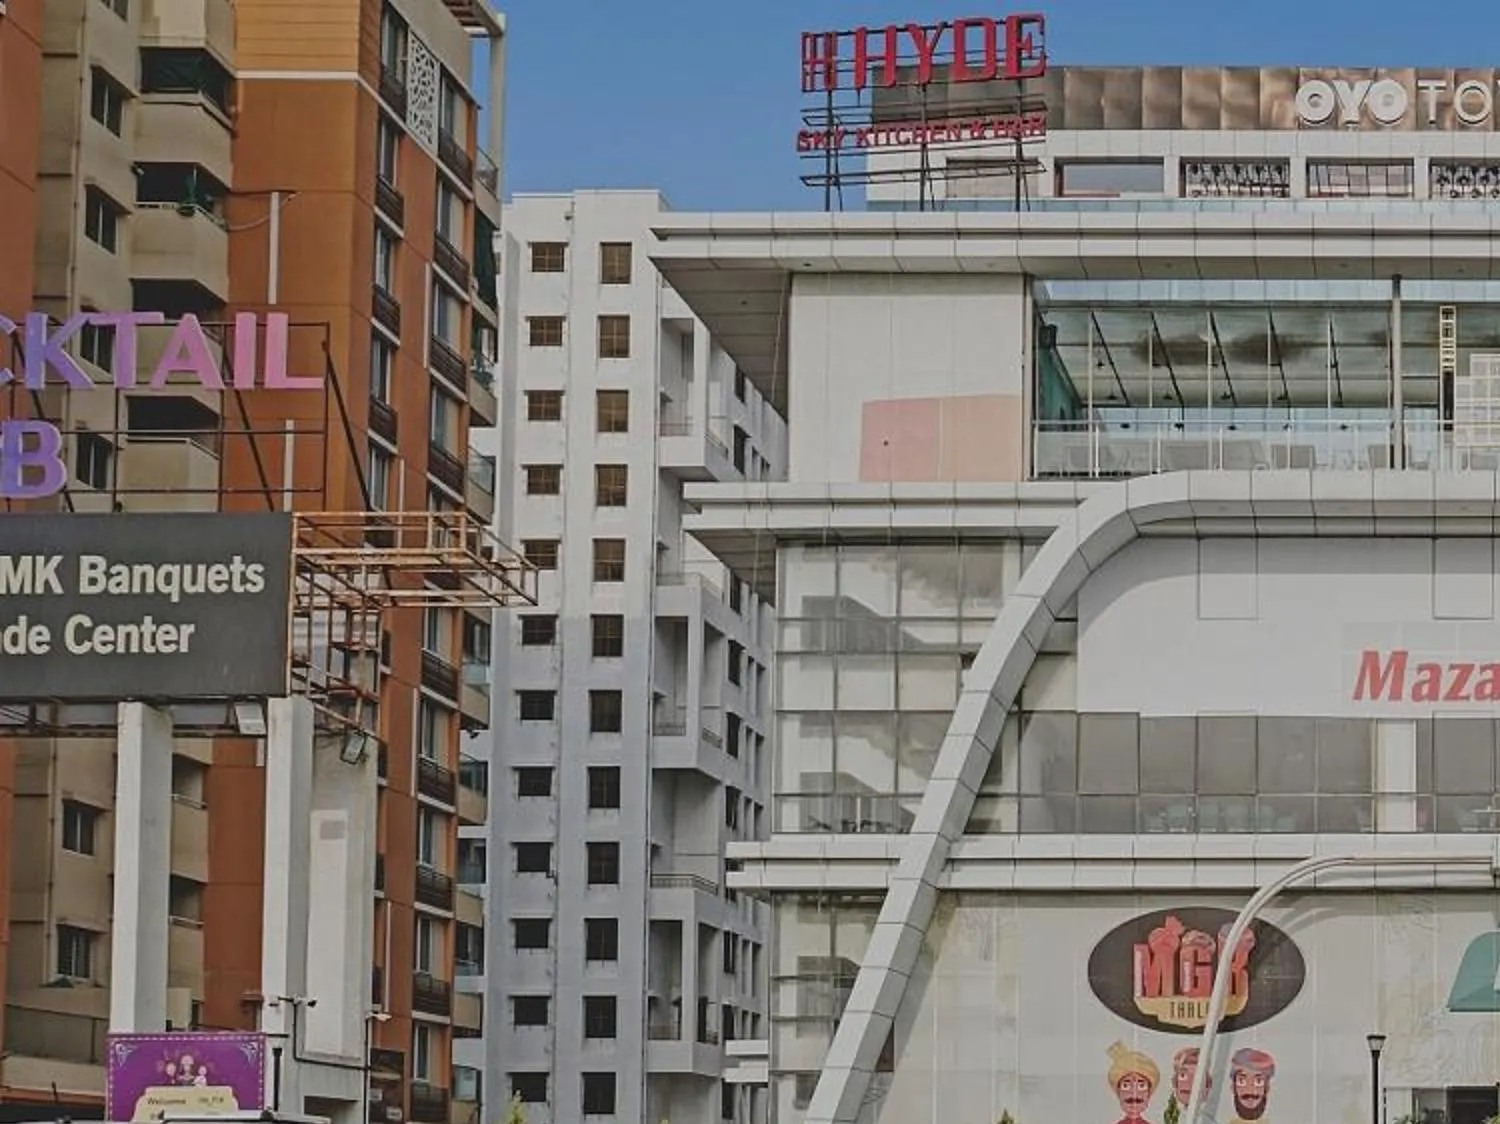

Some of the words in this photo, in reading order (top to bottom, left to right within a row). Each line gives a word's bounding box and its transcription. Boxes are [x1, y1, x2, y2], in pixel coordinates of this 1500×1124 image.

[854, 12, 1047, 91] HYDE
[1296, 79, 1409, 123] OYO
[856, 122, 960, 149] KITCHEN
[0, 311, 325, 390] KTAIL
[79, 555, 265, 602] Banquets
[0, 615, 50, 654] de
[64, 613, 195, 654] Center
